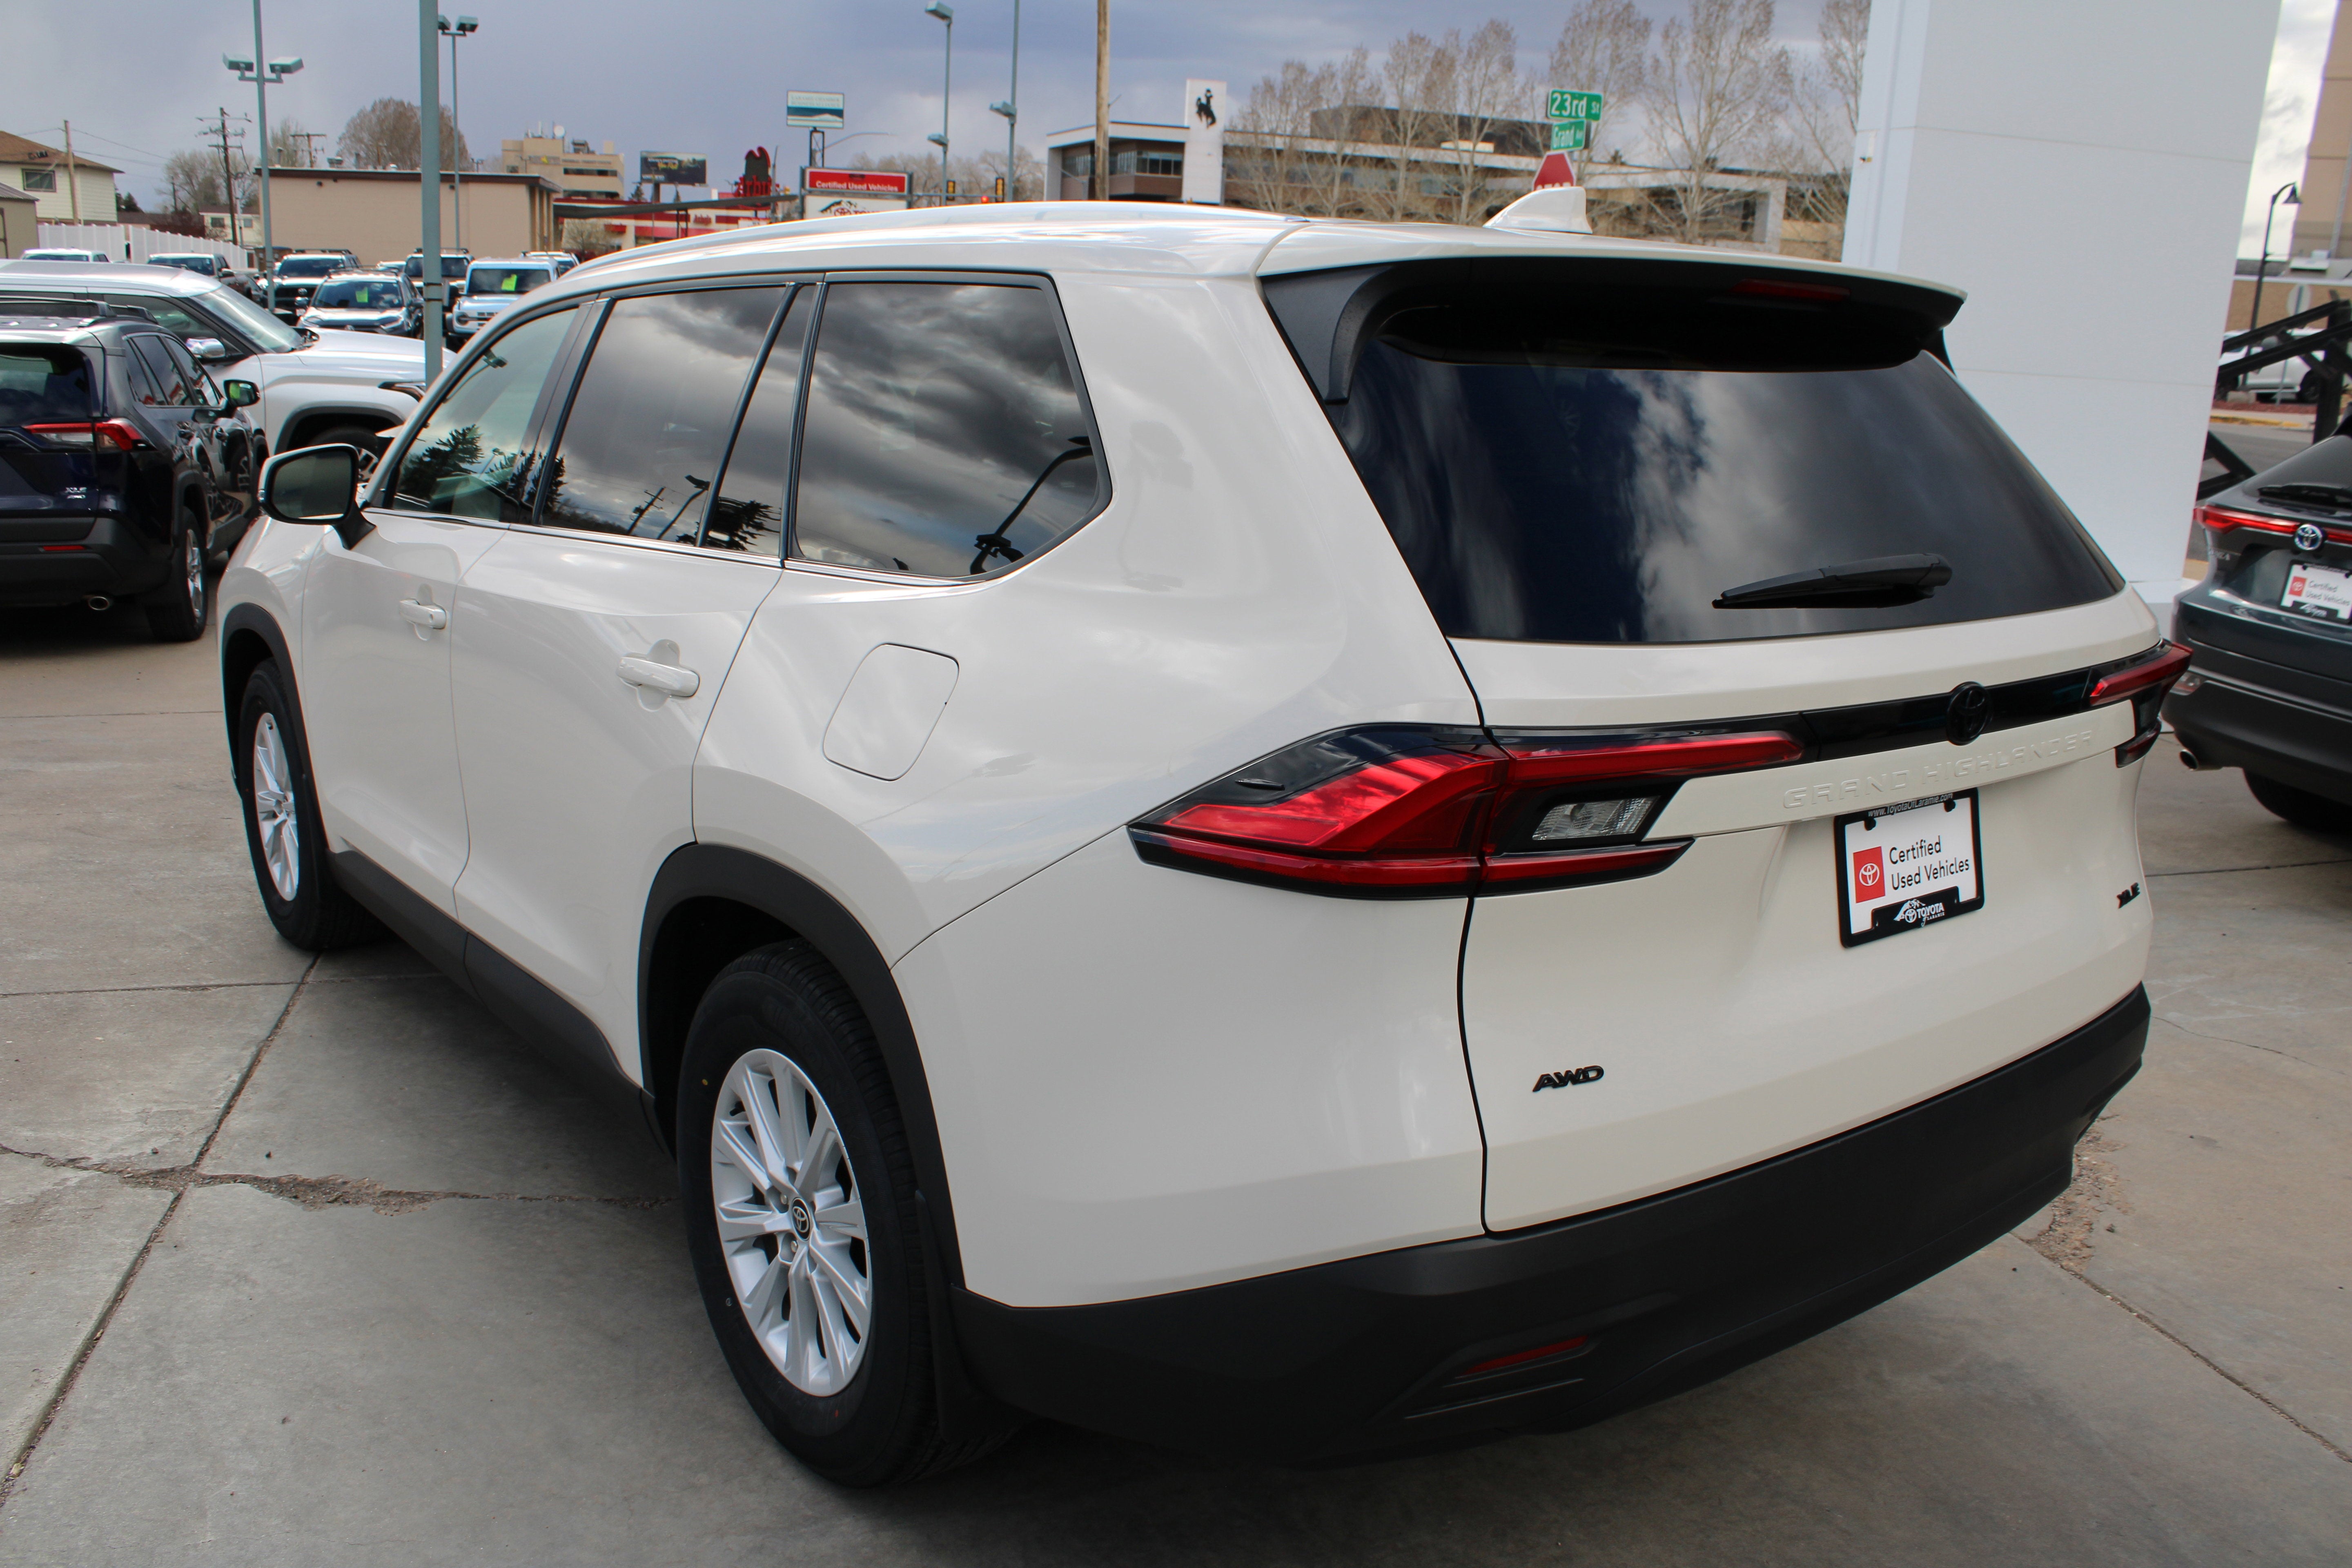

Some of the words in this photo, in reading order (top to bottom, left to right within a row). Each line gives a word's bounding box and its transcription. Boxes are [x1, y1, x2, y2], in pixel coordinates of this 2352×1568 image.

[1552, 93, 1587, 118] 23rd
[1591, 101, 1600, 114] St
[1552, 125, 1575, 148] Grand
[816, 180, 846, 189] Certified
[849, 183, 867, 191] Used
[869, 183, 898, 192] Vehicles
[1783, 770, 1910, 808] GRAND
[1921, 730, 2092, 784] HIGHLANDER
[1889, 835, 1941, 864] Certified
[1891, 866, 1921, 890] Used
[1924, 857, 1969, 881] Vehicles
[2116, 882, 2140, 909] XLE
[1916, 902, 1944, 918] TOYOTA
[1532, 1065, 1604, 1092] AWD
